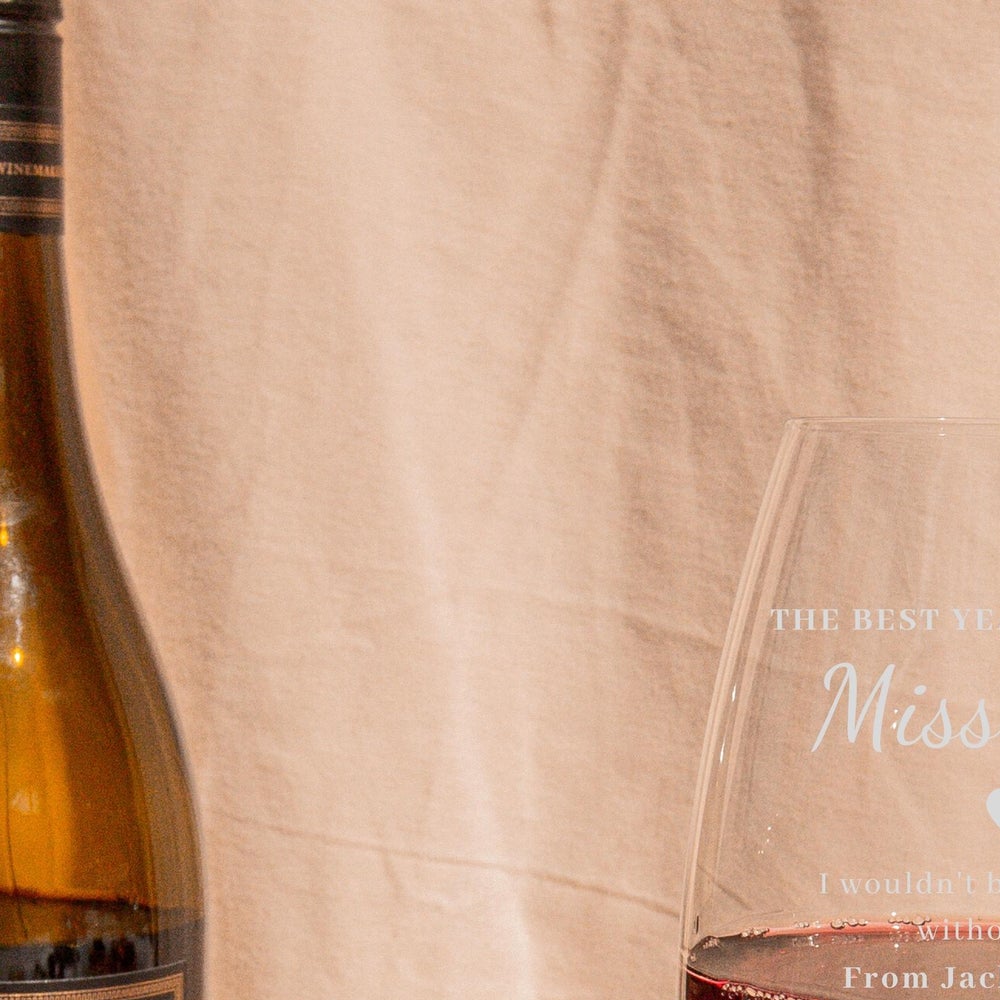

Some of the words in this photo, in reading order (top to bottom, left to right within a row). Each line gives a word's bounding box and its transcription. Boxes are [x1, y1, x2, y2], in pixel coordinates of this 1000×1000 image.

[770, 608, 839, 631] THE
[852, 608, 939, 631] BEST
[819, 872, 828, 894] I
[840, 871, 976, 895] wouldn't
[843, 966, 929, 989] From
